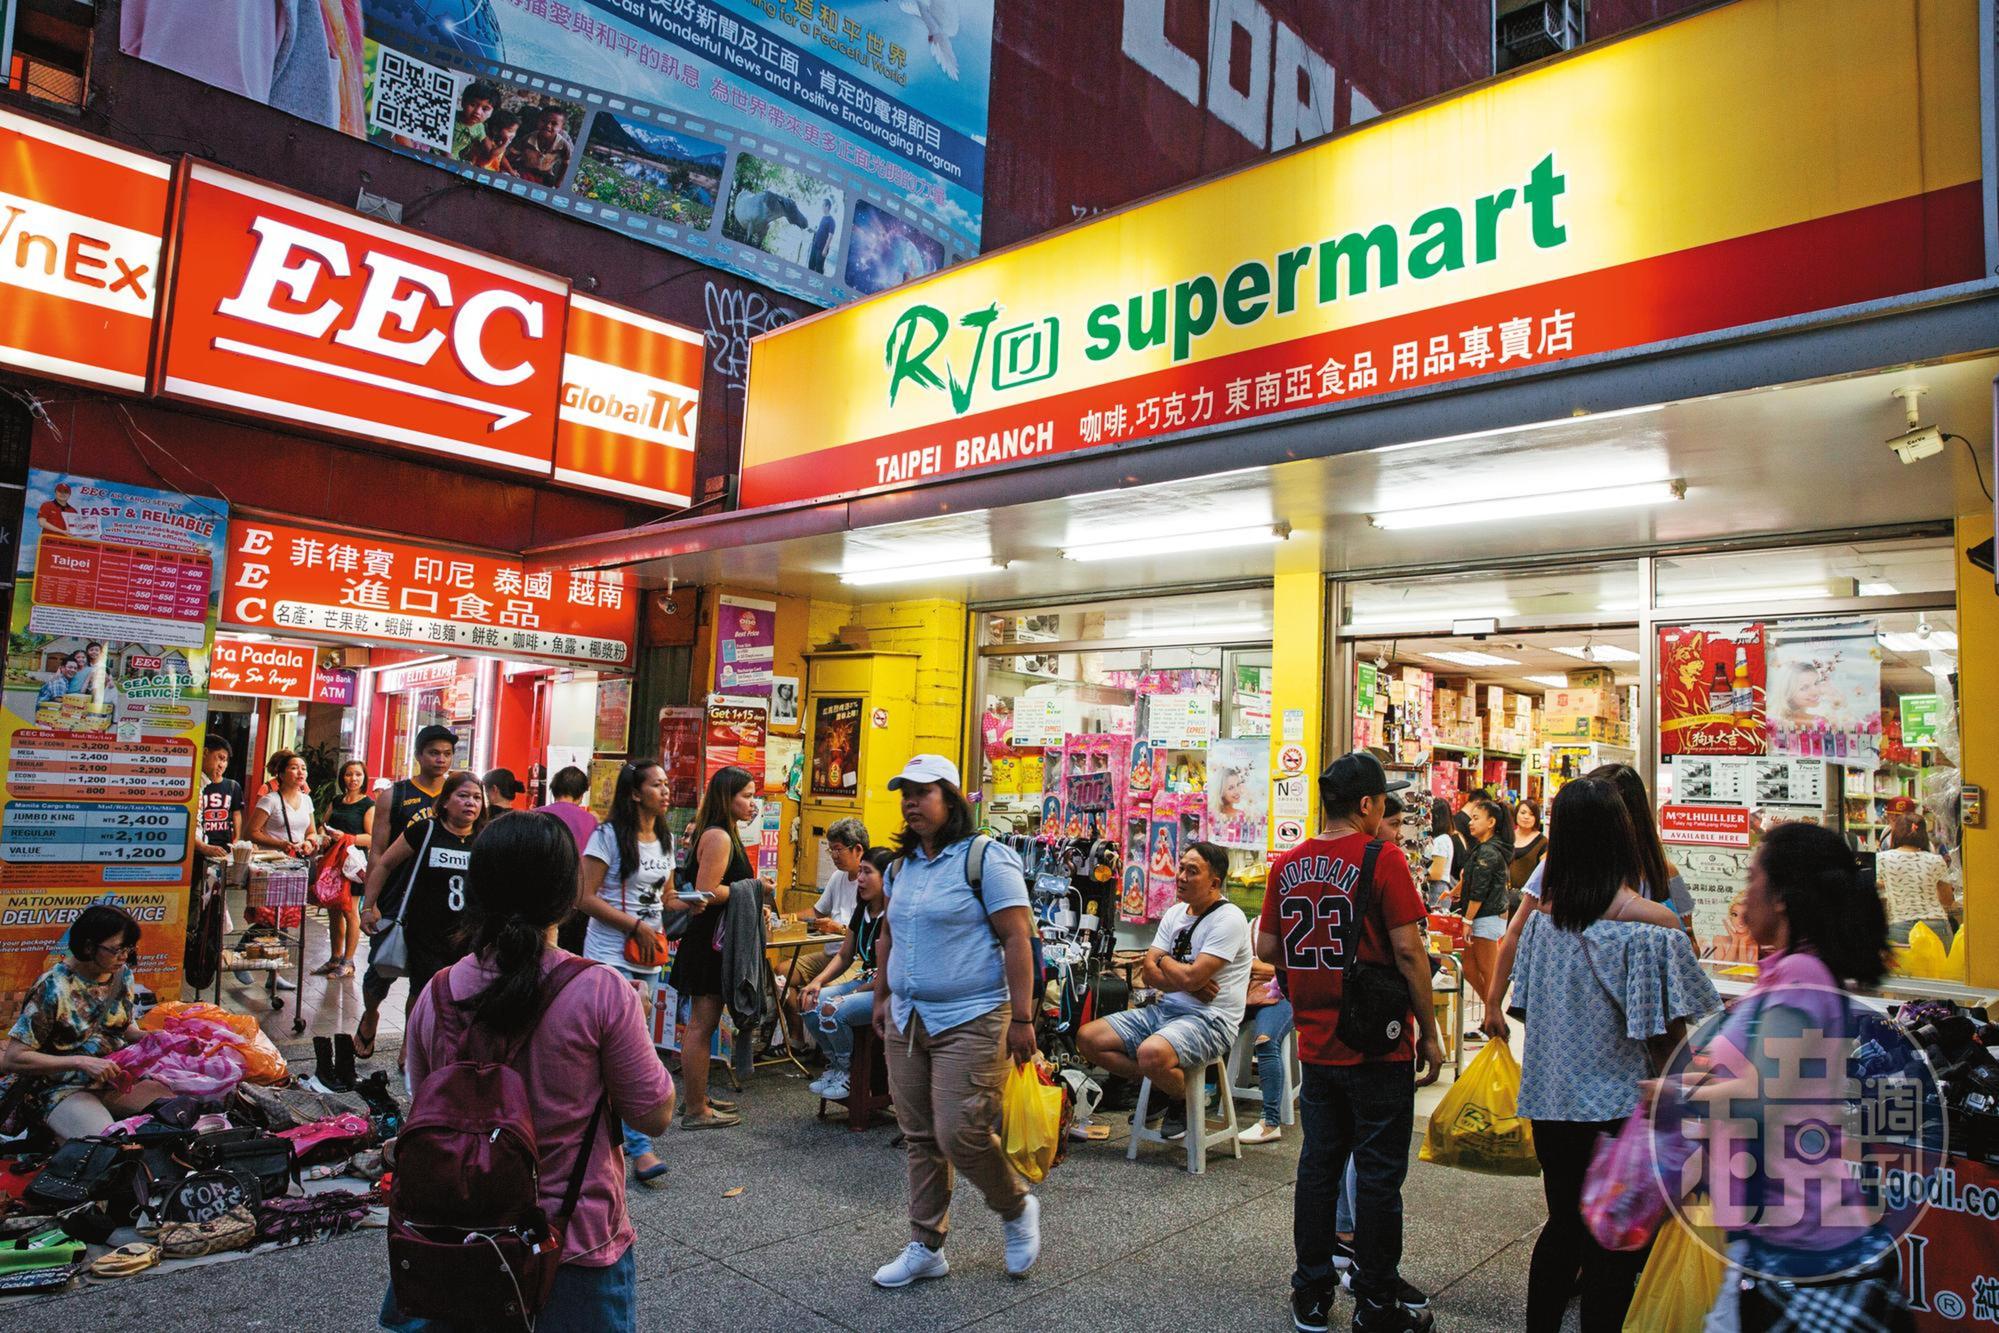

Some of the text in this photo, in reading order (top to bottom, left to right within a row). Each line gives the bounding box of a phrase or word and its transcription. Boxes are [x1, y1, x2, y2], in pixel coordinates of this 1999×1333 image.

[779, 0, 907, 67] 造和平世界
[511, 0, 700, 90] 播愛與和平的訊息
[780, 8, 907, 87] for a Peaceful World
[649, 7, 721, 54] Wonderful
[724, 44, 764, 76] News
[765, 66, 790, 91] and
[794, 84, 839, 114] Positive
[843, 107, 914, 155] Encouraging
[916, 146, 962, 179] Program
[1085, 152, 1567, 362] supermart
[216, 215, 545, 387] EEC
[1225, 350, 1378, 416] 東南亞食品
[1389, 309, 1575, 383] 用品專賣店
[876, 421, 1053, 483] TAIPEI BRANCH
[80, 486, 108, 498] EEC
[80, 507, 214, 537] FAST & RELIABLE
[52, 554, 91, 569] Taipei
[235, 528, 274, 622] EEC
[290, 537, 624, 610] 菲律賓 印尼 泰國 越南
[340, 577, 540, 628] 進口食品
[134, 658, 160, 668] EEC
[241, 646, 303, 668] Padala
[316, 672, 352, 684] Mega Bank
[407, 670, 429, 682] ELITE
[123, 677, 150, 690] SEA
[127, 688, 181, 700] SERVICE
[319, 686, 345, 699] ATM
[711, 708, 730, 719] Get
[732, 709, 754, 719] 1+15
[20, 729, 38, 737] EEC
[1692, 729, 1740, 746] 狗年大吉
[81, 742, 110, 751] 3,200
[80, 753, 108, 762] 2,400
[139, 756, 168, 765] 2,500
[1531, 753, 1541, 770] E
[79, 764, 167, 776] 2,100 2,200
[78, 776, 107, 785] 1,200
[119, 777, 147, 786] 1,300
[159, 778, 186, 787] 1,400
[13, 813, 169, 826] JUMBO KING 2,400
[10, 829, 168, 843] REGULAR 2,100
[1671, 832, 1740, 842] AVAILABLE HERE
[9, 846, 166, 859] VALUE 1,200
[438, 852, 470, 866] Smi
[1280, 856, 1361, 895] JORDAN
[448, 875, 465, 911] 8
[8, 895, 164, 907] NATIONWIDE (TAIWAN)
[127, 907, 165, 921] VICE
[1280, 896, 1353, 970] 23
